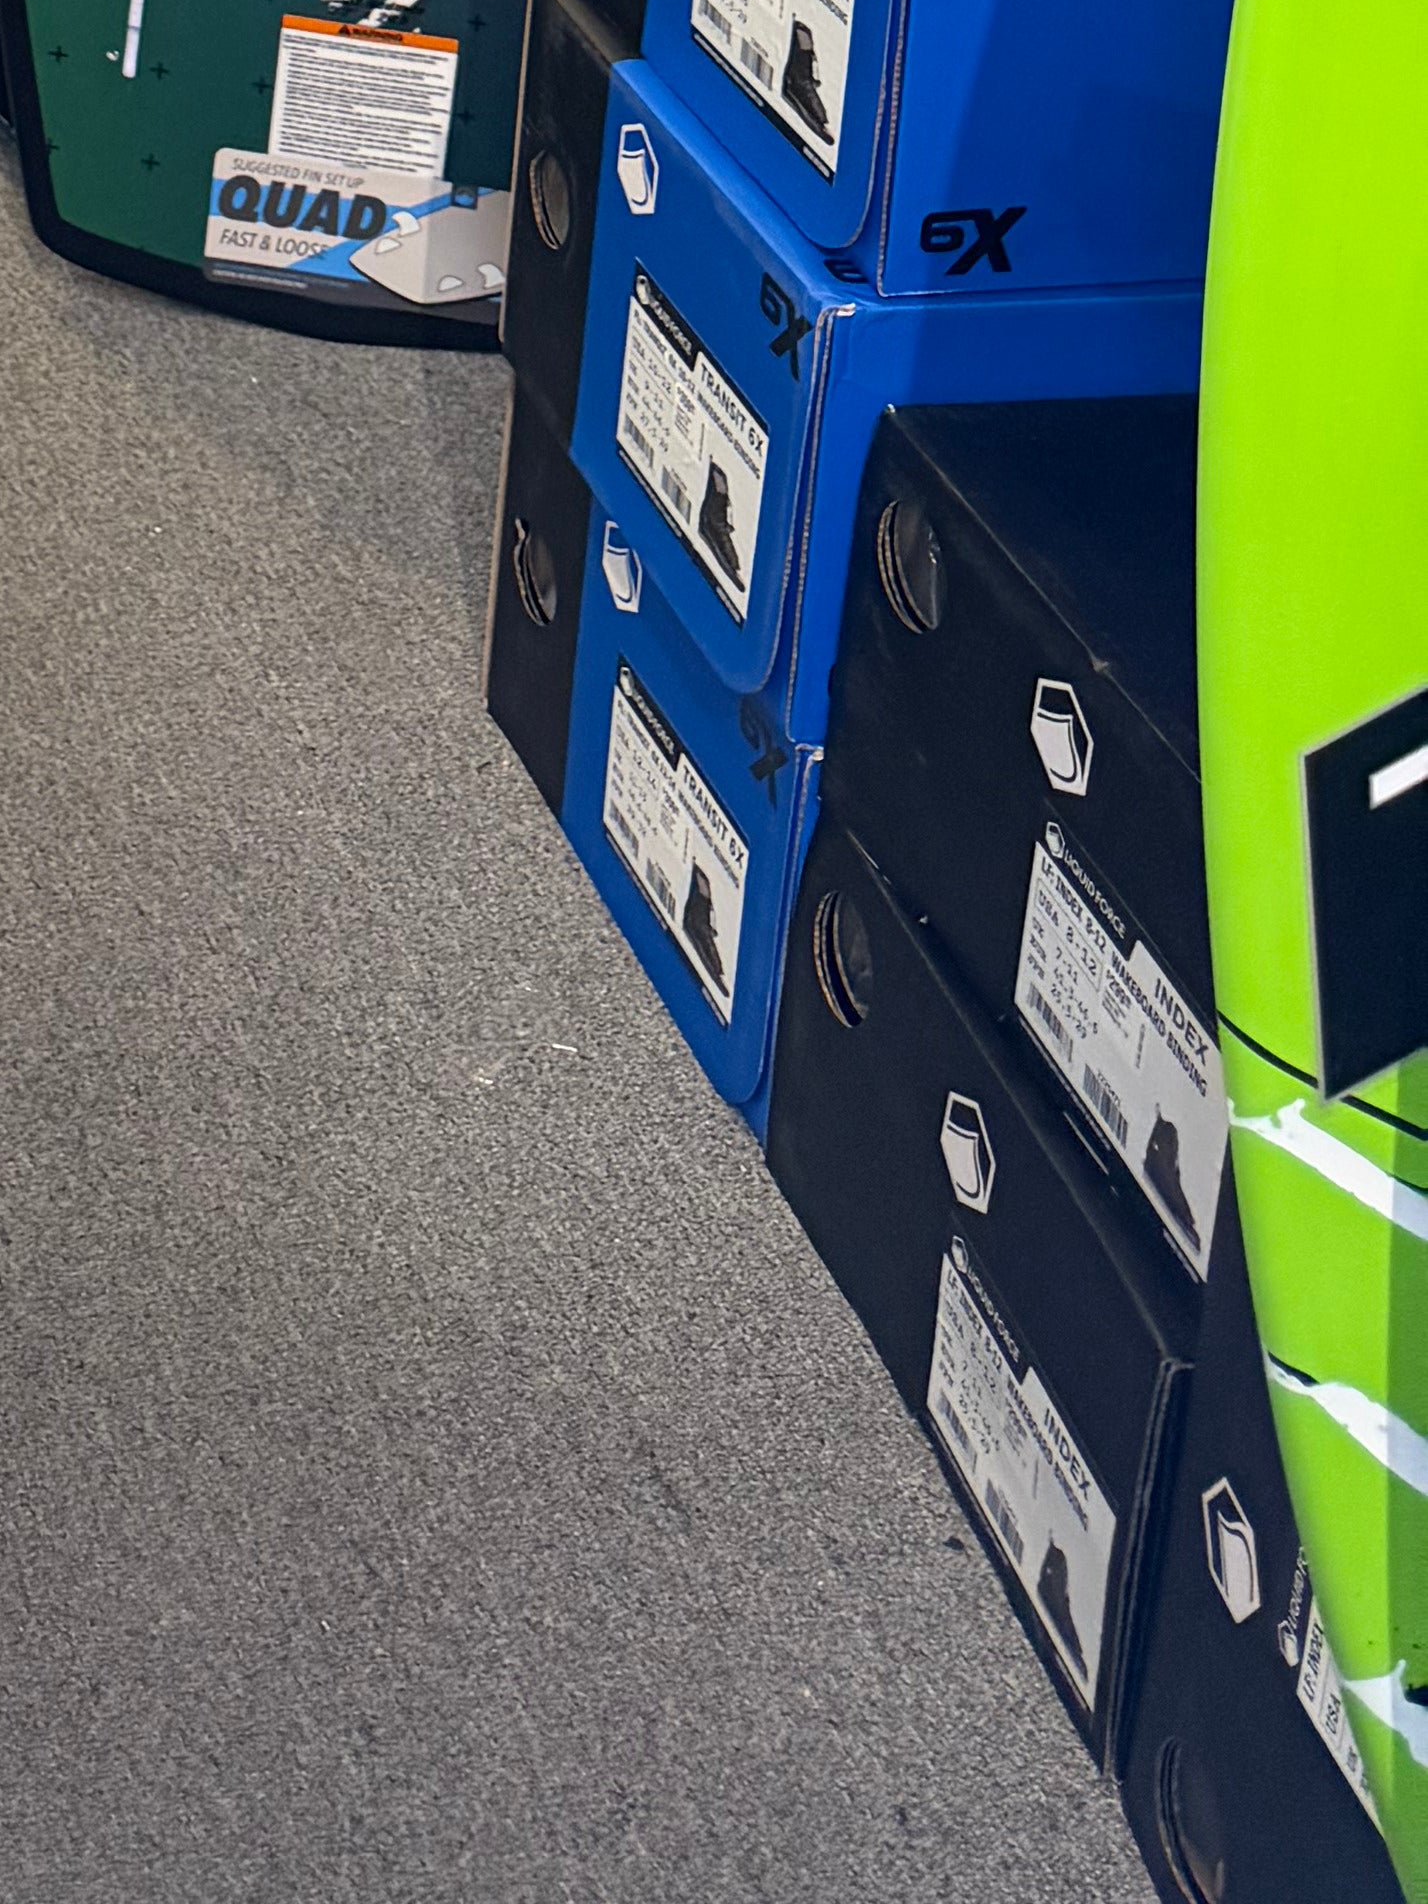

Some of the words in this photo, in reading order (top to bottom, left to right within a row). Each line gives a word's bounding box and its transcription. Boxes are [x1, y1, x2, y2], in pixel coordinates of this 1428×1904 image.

[218, 175, 387, 241] QUAD
[232, 157, 300, 180] SUGGESTED
[302, 168, 323, 182] FIN
[220, 228, 257, 249] FAST
[259, 234, 270, 250] &
[275, 236, 329, 259] LOOSE
[919, 206, 1028, 275] 6X
[760, 272, 814, 382] 6X
[699, 362, 745, 436] TRANSIT
[745, 422, 763, 460] 6X
[682, 763, 726, 844] TRANSIT
[1037, 887, 1060, 929] USA
[1065, 921, 1098, 981] 8-12
[1054, 873, 1083, 923] INDEX
[1110, 949, 1166, 1040] WAKEBOARD
[1165, 1028, 1208, 1102] BINDING
[1153, 973, 1209, 1072] INDEX
[1043, 1404, 1091, 1506] INDEX
